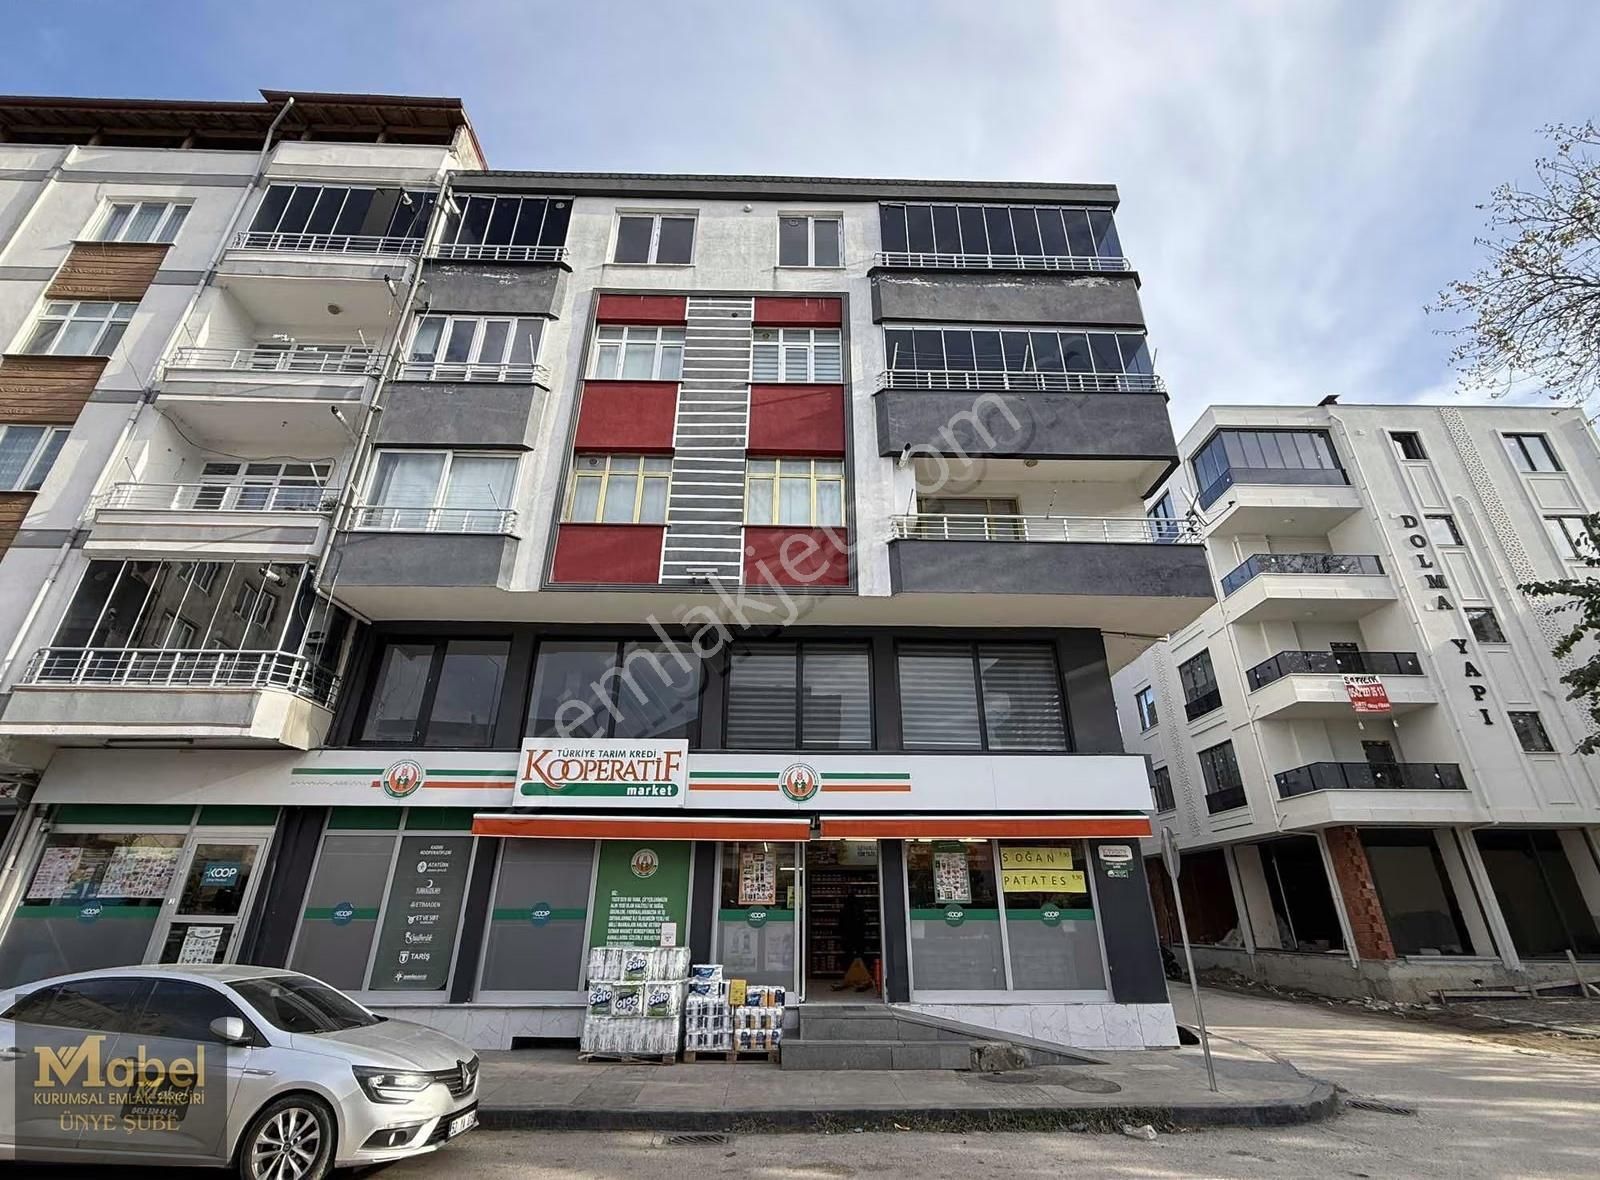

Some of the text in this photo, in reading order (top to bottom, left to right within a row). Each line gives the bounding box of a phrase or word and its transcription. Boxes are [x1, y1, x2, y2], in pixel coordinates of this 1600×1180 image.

[1400, 514, 1494, 725] DOLMA YAPI
[557, 748, 657, 758] TÜRKİYE TARIM KREDİ
[522, 749, 682, 788] KOOPERATİF
[627, 785, 672, 796] market
[1004, 875, 1066, 886] PATATES
[627, 960, 646, 971] Solo
[591, 991, 612, 1005] Solo
[649, 993, 669, 1006] Solo
